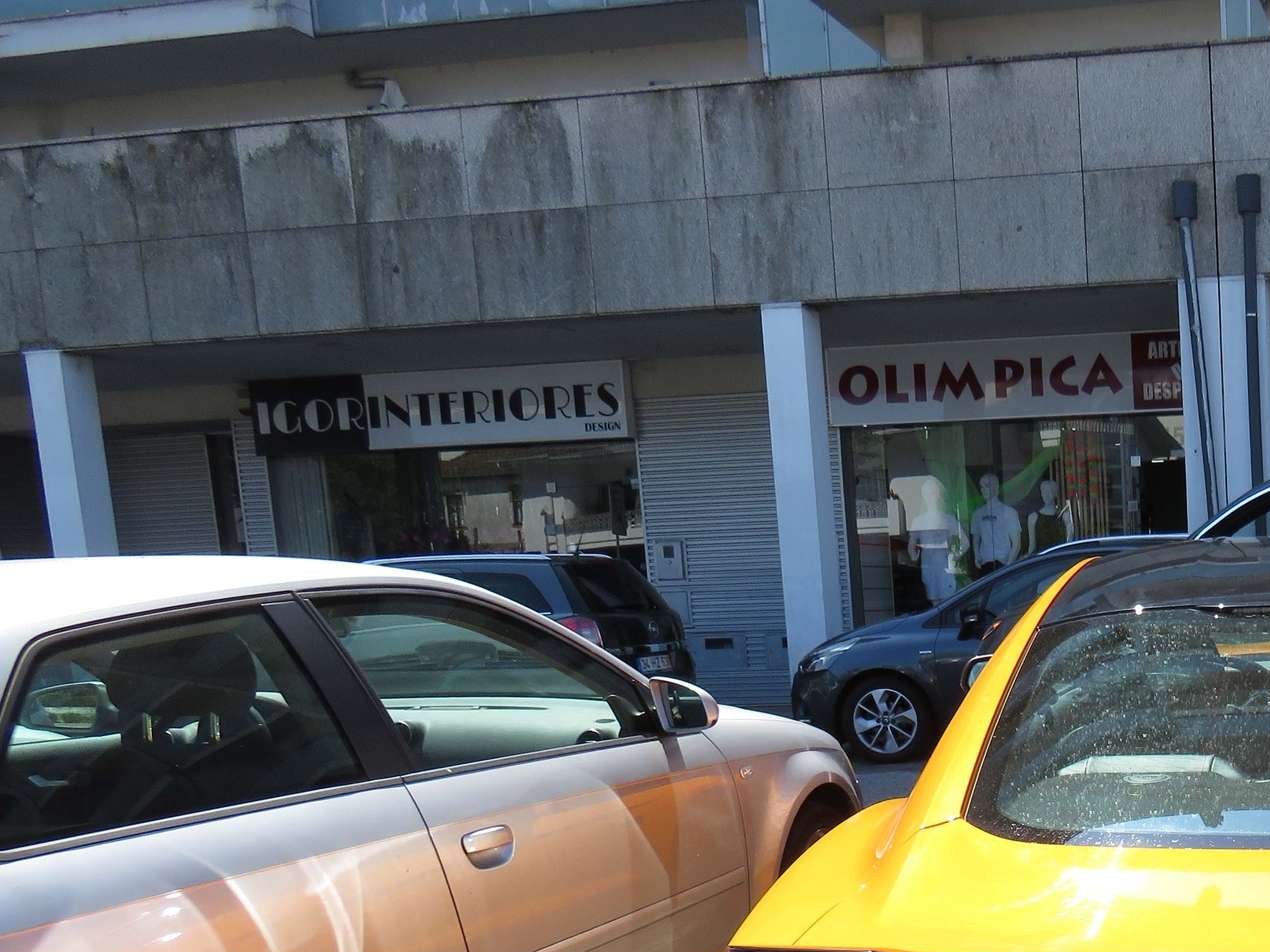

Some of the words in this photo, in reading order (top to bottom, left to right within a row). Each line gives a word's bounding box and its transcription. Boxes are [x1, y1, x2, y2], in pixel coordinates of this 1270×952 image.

[838, 351, 1124, 406] OLIMPICA
[256, 397, 366, 436] IGOR
[366, 381, 620, 430] INTERIORES
[584, 420, 622, 433] DESIGN
